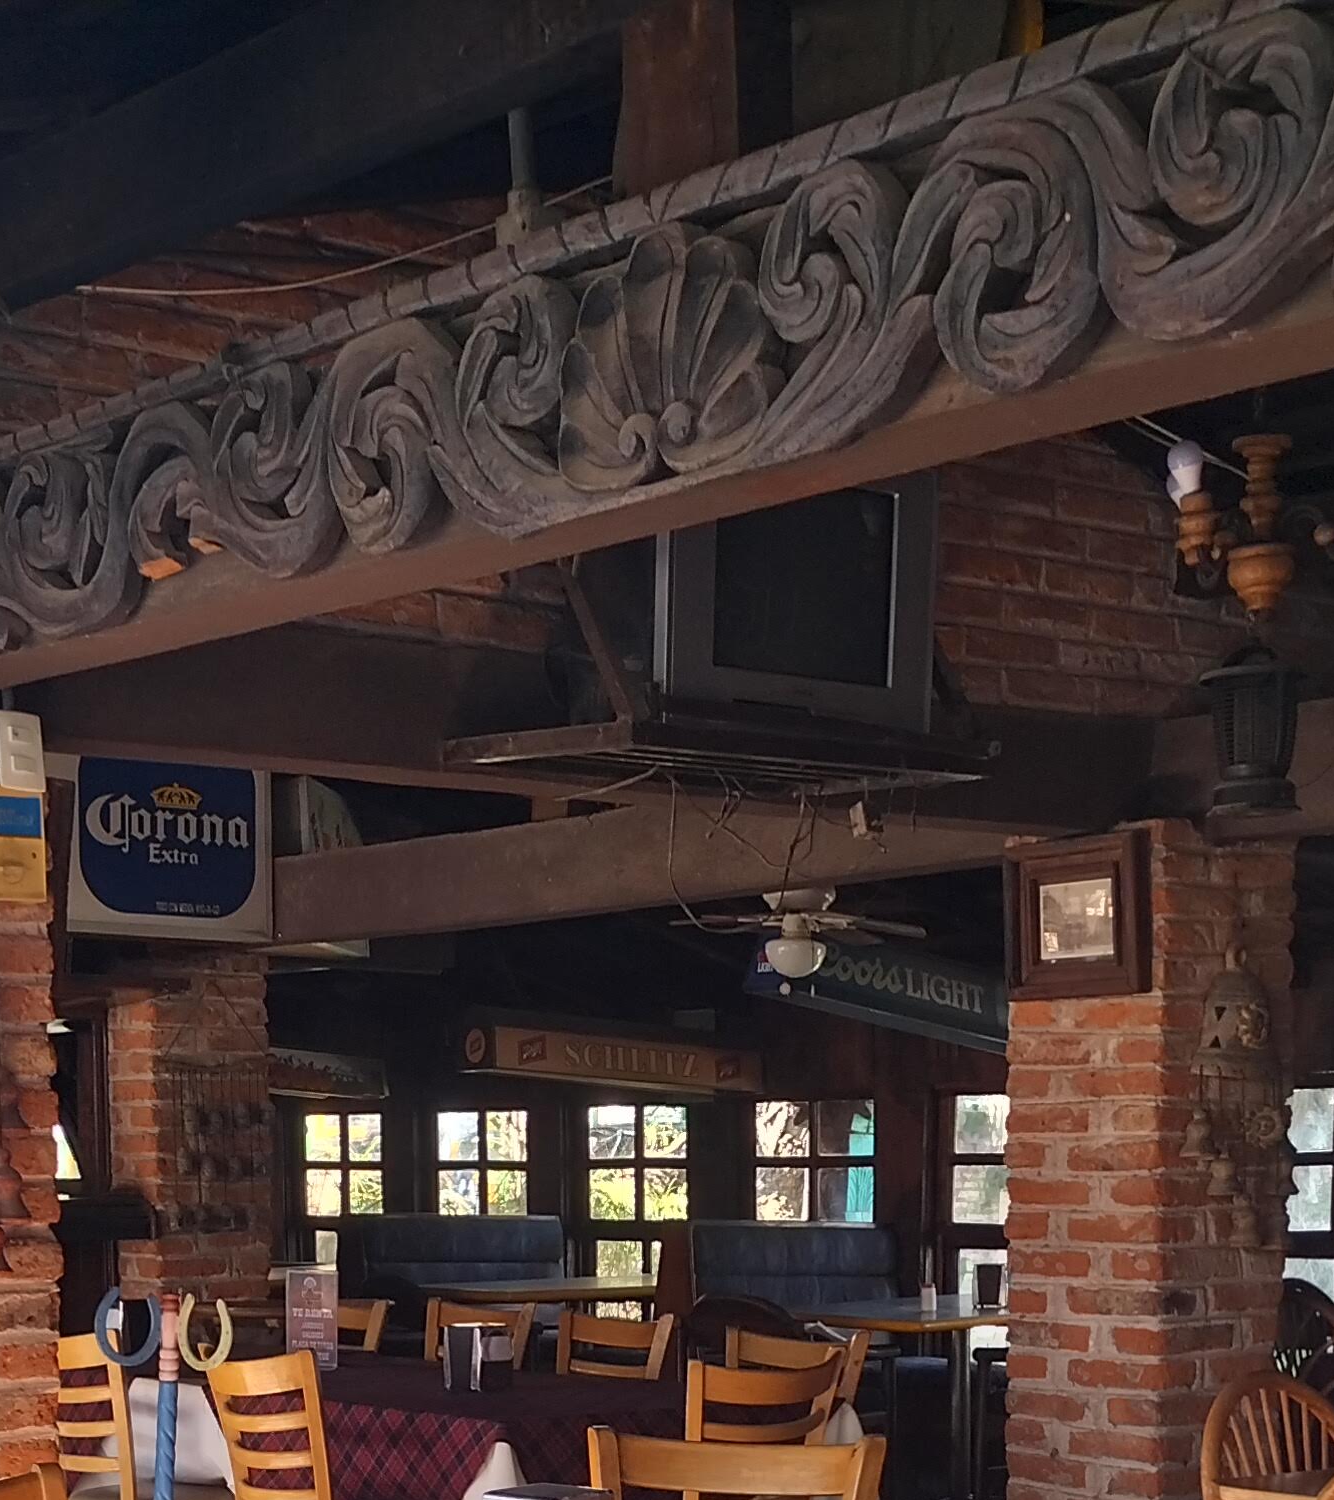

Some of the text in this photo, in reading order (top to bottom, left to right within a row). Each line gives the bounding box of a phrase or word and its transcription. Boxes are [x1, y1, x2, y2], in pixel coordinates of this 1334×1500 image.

[85, 793, 250, 853] Corona
[148, 842, 199, 865] Extra
[905, 967, 985, 1014] LIGHT
[565, 1040, 700, 1078] SCHLITZ
